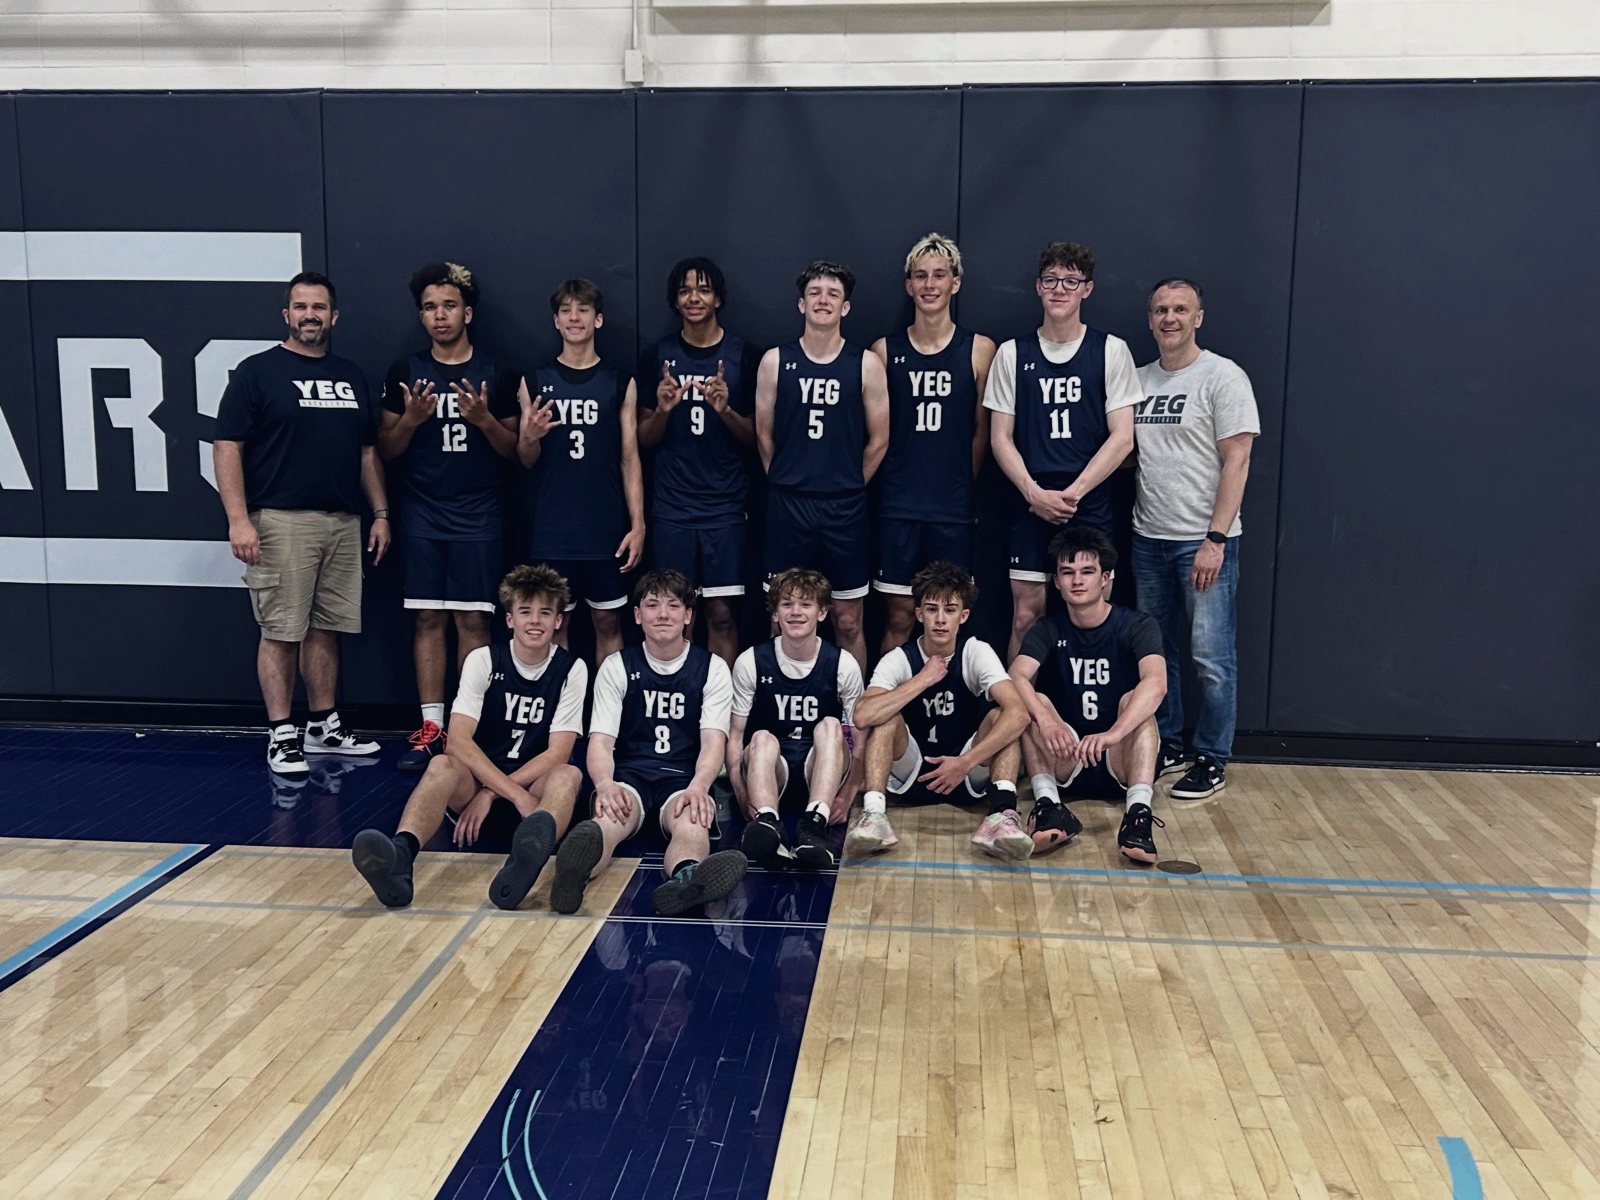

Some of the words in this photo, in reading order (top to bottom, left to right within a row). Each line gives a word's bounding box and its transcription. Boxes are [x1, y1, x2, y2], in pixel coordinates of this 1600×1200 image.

[292, 380, 356, 400] YEG
[678, 374, 713, 401] YE
[799, 378, 841, 405] YEG
[908, 370, 952, 397] YEG
[1038, 376, 1082, 404] YEG
[431, 392, 473, 419] YE
[555, 399, 599, 425] YEG
[915, 402, 942, 432] 10
[1138, 394, 1188, 415] YEG
[690, 406, 705, 435] 9
[807, 409, 825, 439] 5
[1050, 408, 1072, 439] 11
[441, 423, 467, 452] 12
[569, 430, 585, 459] 3
[1069, 657, 1110, 685] YEG
[504, 692, 546, 724] YEG
[643, 689, 685, 720] YEG
[774, 694, 819, 722] YEG
[922, 690, 955, 718] YEG
[1082, 690, 1098, 721] 6
[506, 729, 526, 759] 7
[654, 725, 671, 754] 8
